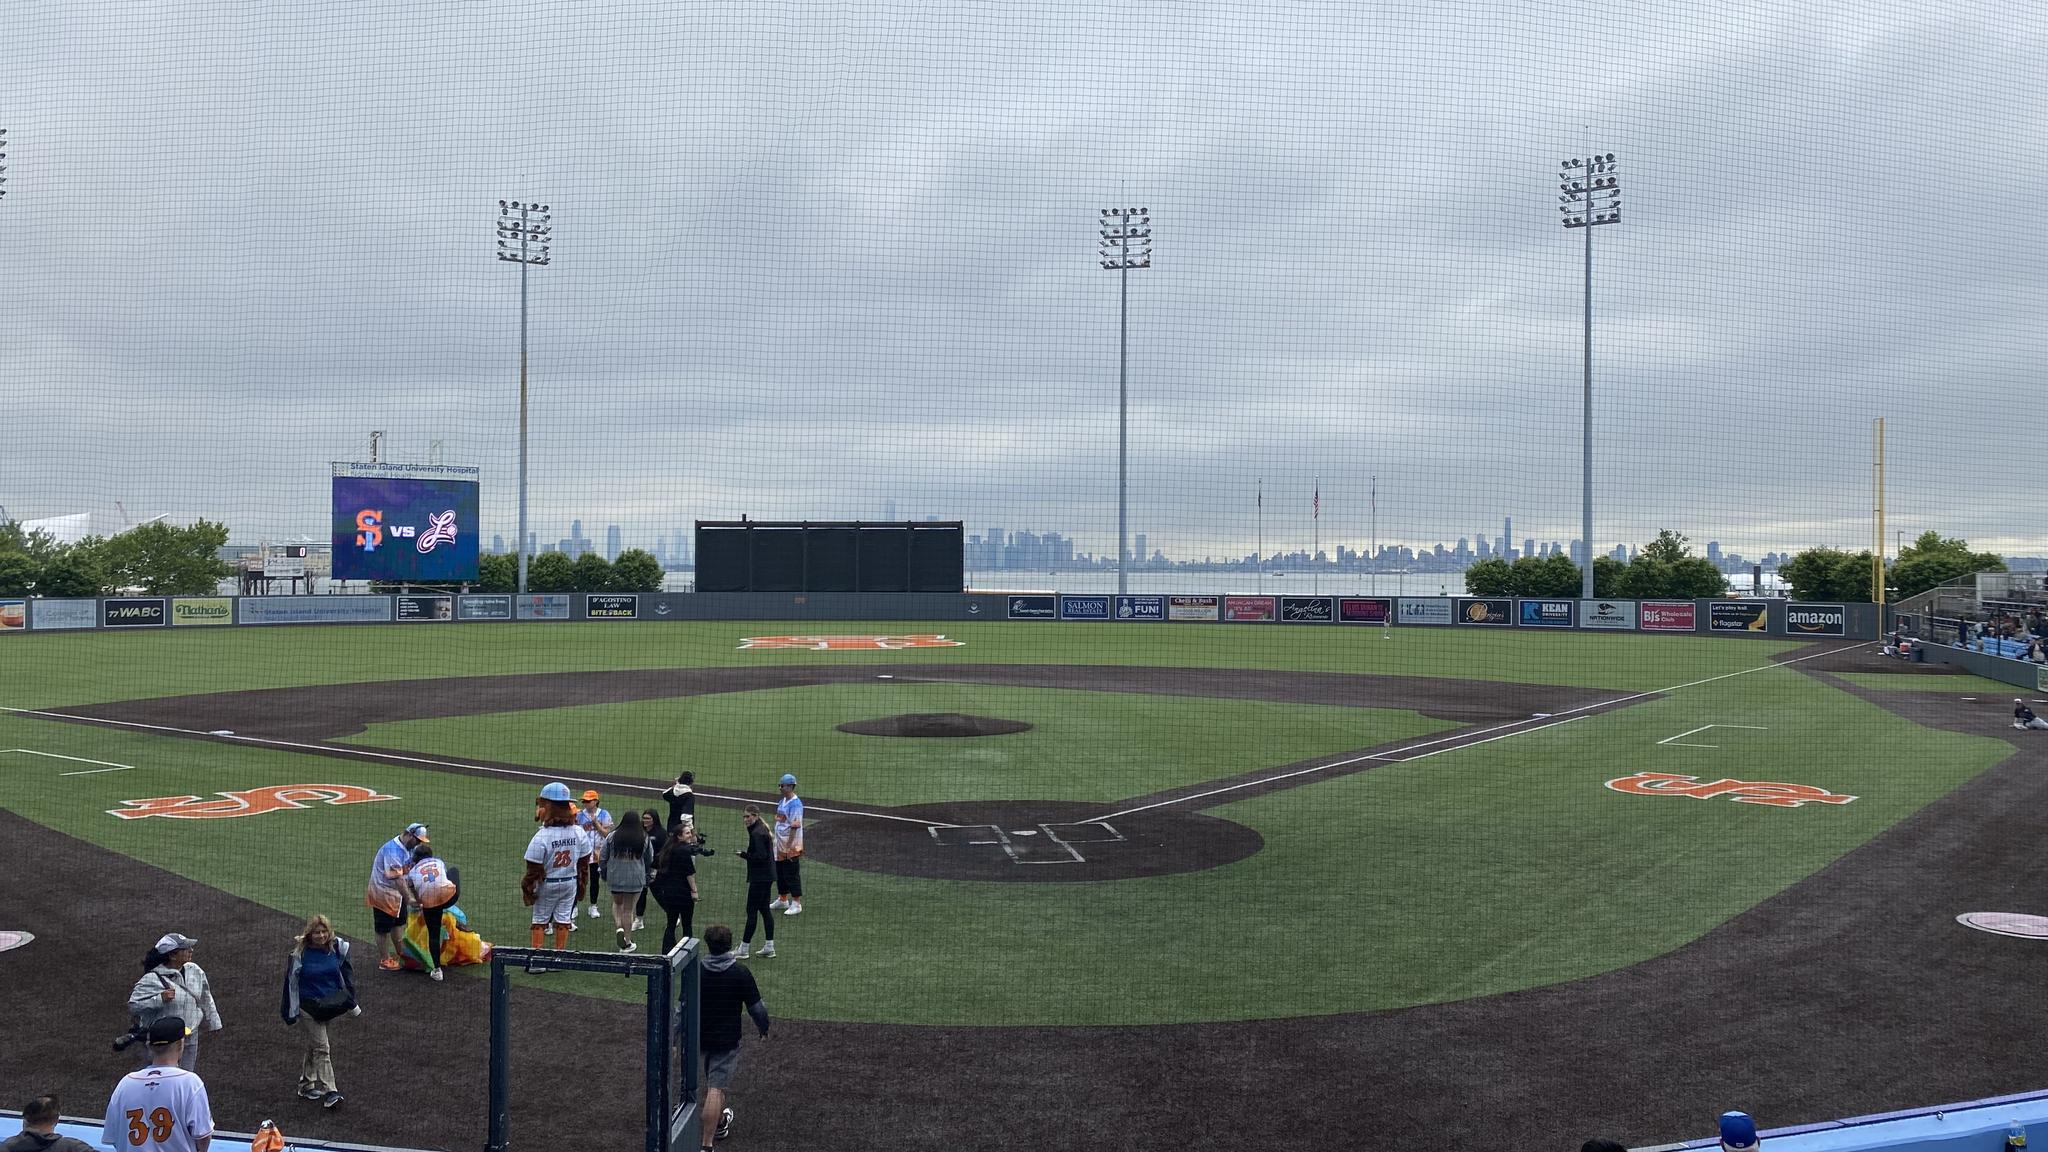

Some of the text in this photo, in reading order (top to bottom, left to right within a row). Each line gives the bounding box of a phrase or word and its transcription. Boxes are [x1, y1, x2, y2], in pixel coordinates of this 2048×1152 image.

[350, 462, 479, 474] Staten Island University Hospital
[120, 607, 161, 618] WABC
[176, 604, 229, 618] Nathan's
[1135, 605, 1159, 614] FUN!
[1542, 603, 1568, 612] KEAN
[1644, 609, 1660, 623] BJ's
[1788, 612, 1842, 624] amazon
[1719, 619, 1744, 628] flagstar
[551, 838, 576, 849] FRANKIE
[126, 1107, 175, 1146] 39
